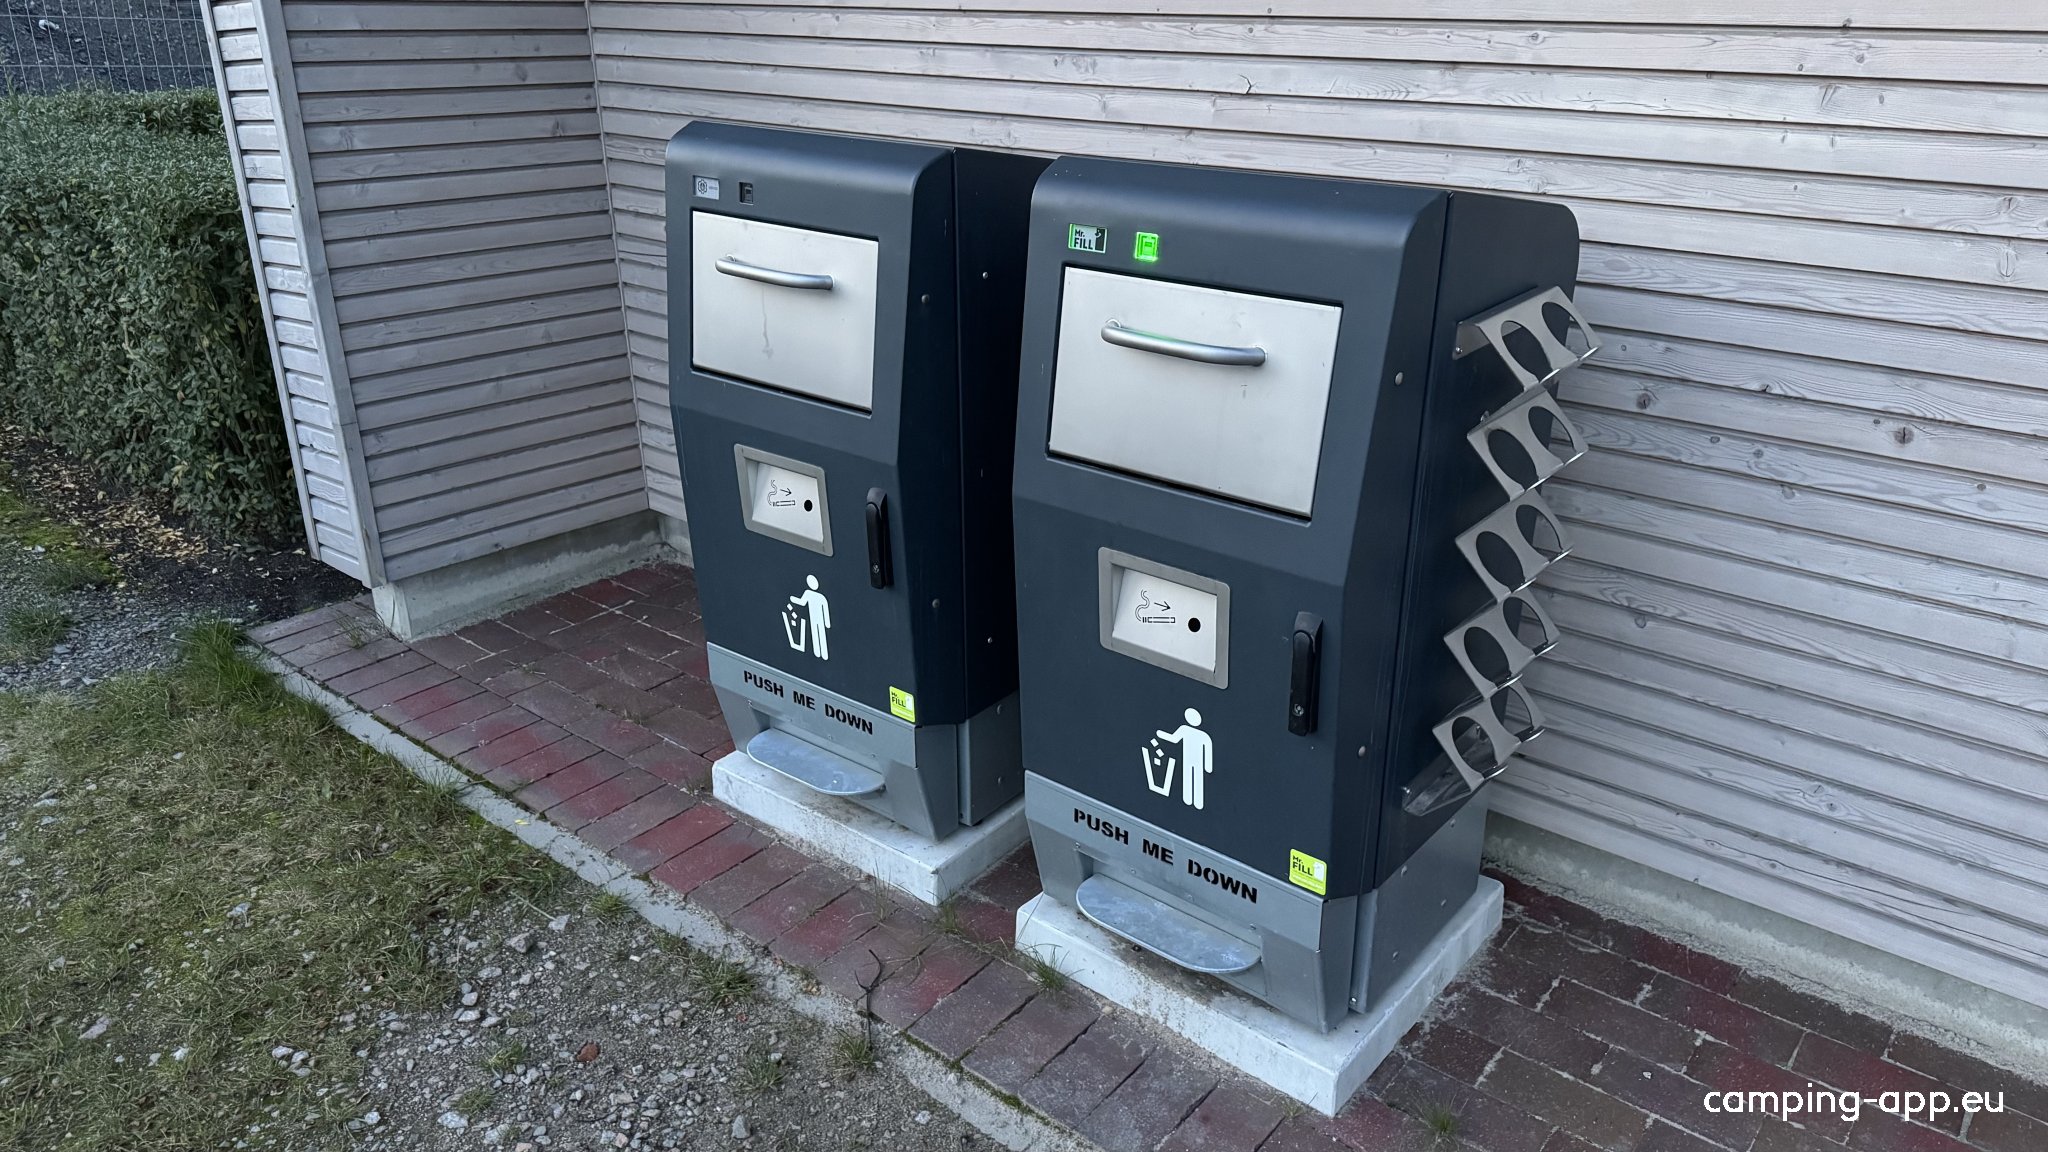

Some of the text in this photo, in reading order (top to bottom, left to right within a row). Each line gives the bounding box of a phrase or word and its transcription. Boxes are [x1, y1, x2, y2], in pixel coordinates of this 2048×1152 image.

[1075, 228, 1085, 237] Mr.
[1074, 238, 1093, 250] FILL
[743, 670, 784, 698] PUSH
[793, 690, 816, 710] ME
[824, 703, 873, 735] DOWN
[891, 696, 906, 708] FILL
[1073, 808, 1129, 845] PUSH
[1142, 838, 1174, 866] ME
[1187, 858, 1258, 904] DOWN
[1292, 861, 1313, 876] FILL
